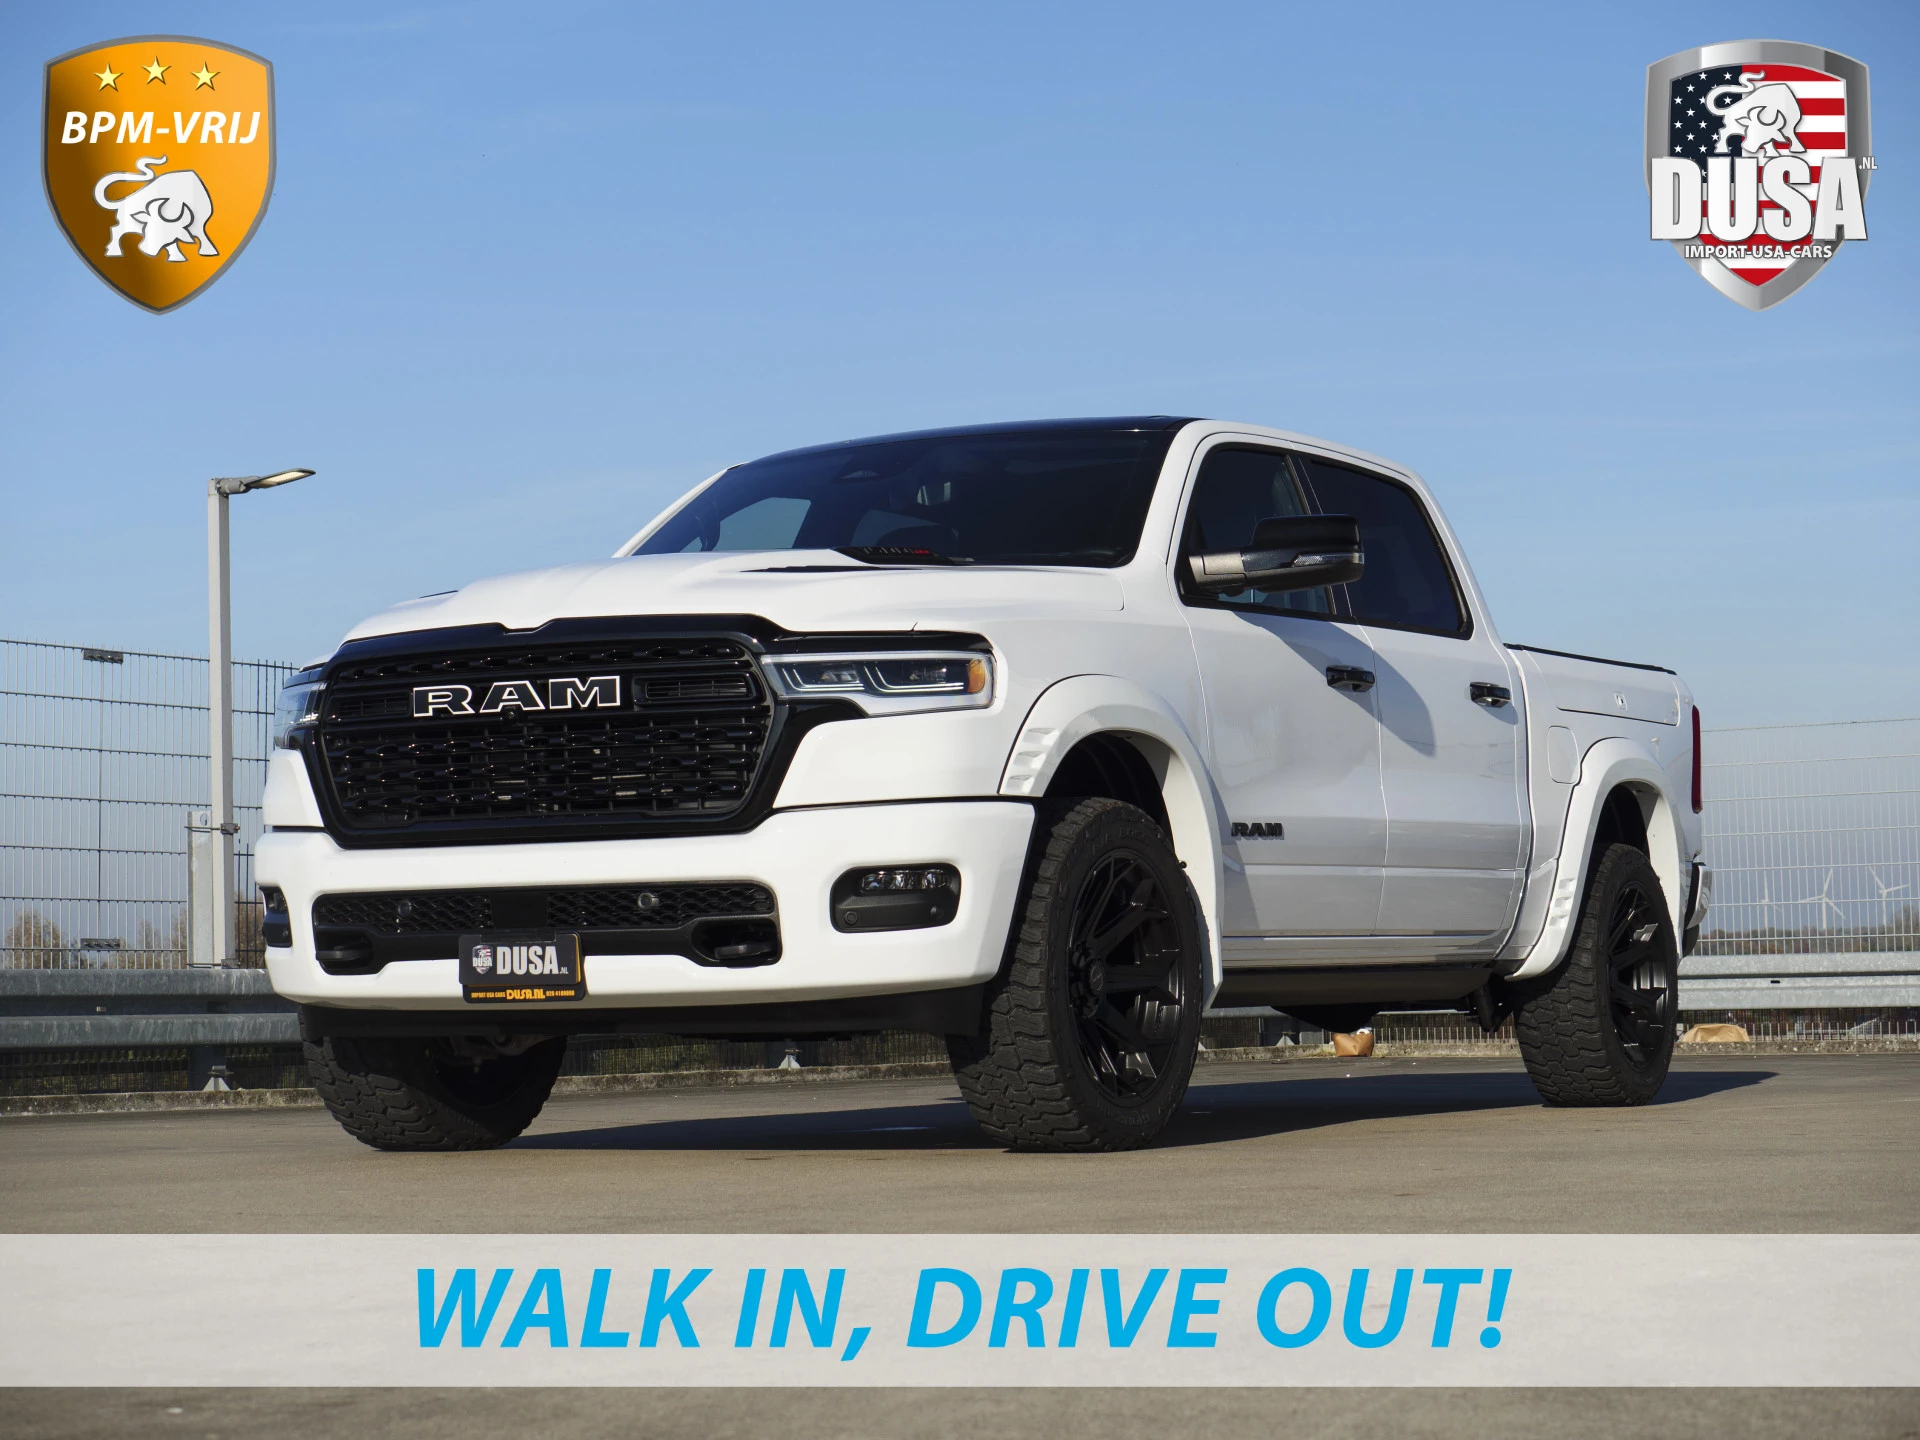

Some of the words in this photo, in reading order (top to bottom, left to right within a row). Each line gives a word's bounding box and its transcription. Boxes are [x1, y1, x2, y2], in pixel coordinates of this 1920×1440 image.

[413, 675, 620, 717] RAM
[1231, 822, 1283, 837] RAM
[472, 956, 493, 967] DUSA
[506, 989, 546, 1000] DUSA.NL
